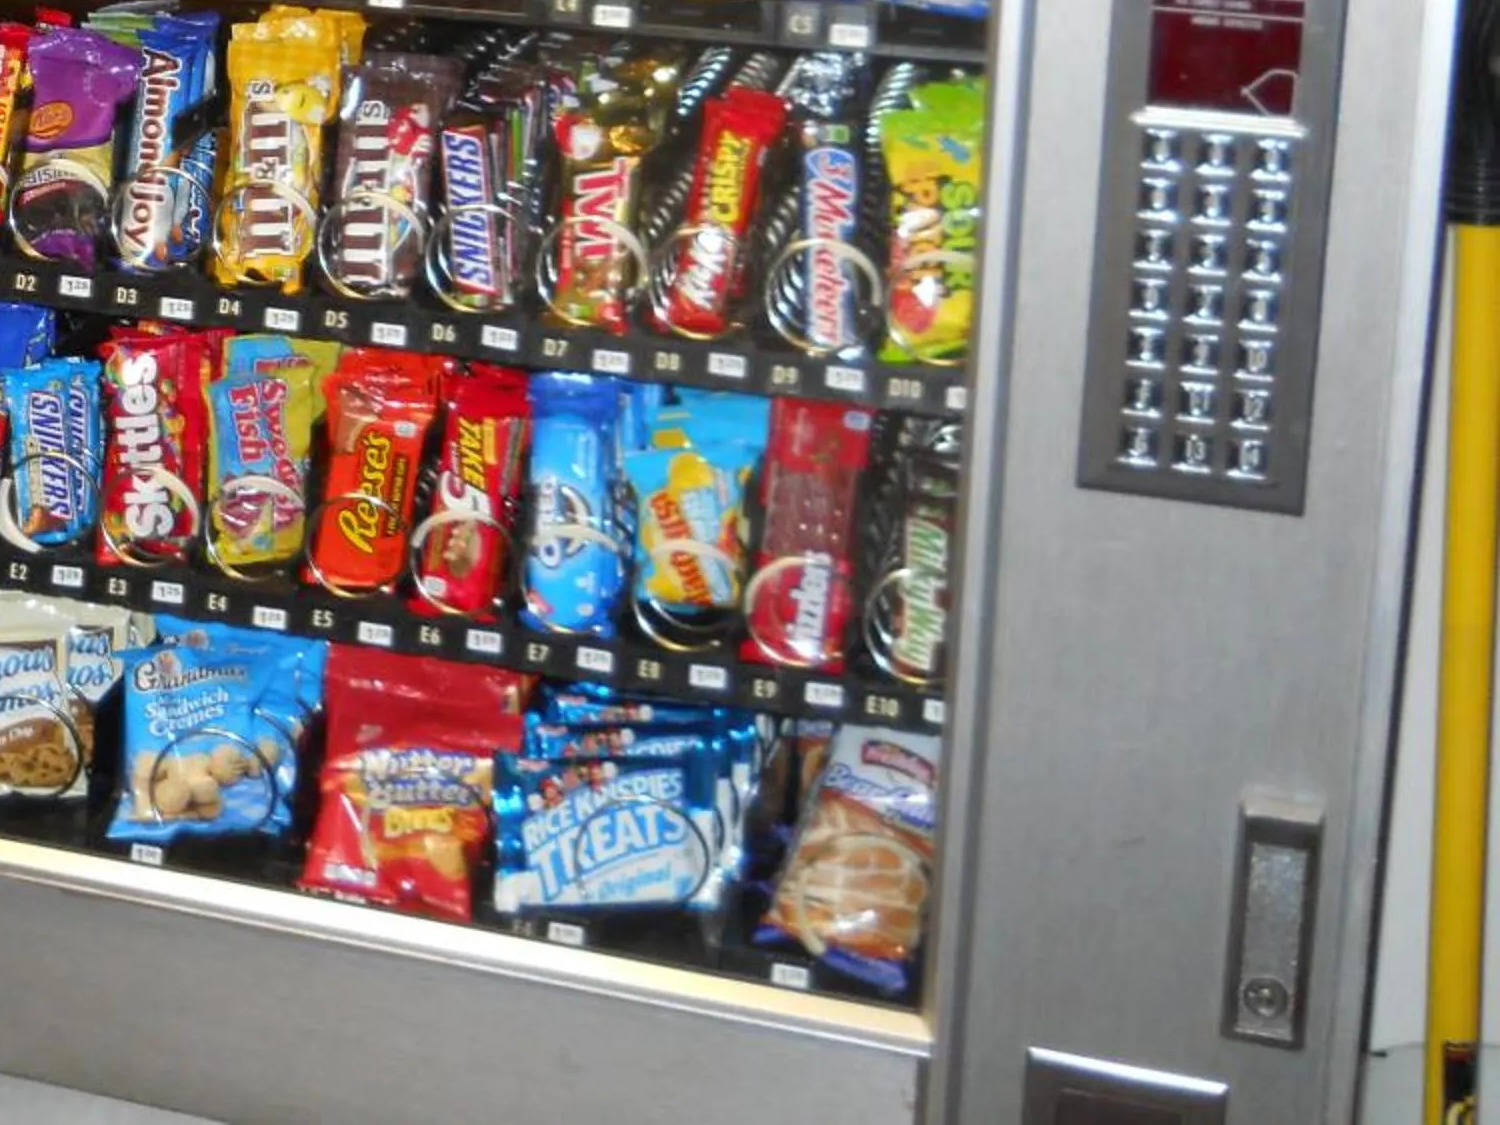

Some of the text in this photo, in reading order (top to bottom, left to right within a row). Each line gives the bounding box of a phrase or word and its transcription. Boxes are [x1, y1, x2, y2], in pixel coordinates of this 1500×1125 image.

[123, 183, 165, 248] Joy
[15, 273, 37, 292] D2
[116, 286, 137, 305] D3
[219, 298, 241, 316] D4
[325, 310, 349, 329] D5
[432, 323, 456, 342] D6
[543, 337, 568, 357] D7
[228, 382, 270, 465] Fish
[457, 416, 487, 491] TAKE
[9, 562, 28, 581] E2
[108, 577, 128, 596] E3
[207, 592, 228, 612] E4
[312, 608, 333, 628] E5
[420, 626, 441, 645] E6
[527, 642, 549, 662] E7
[754, 678, 778, 699] E9
[865, 694, 900, 717] E10
[522, 800, 575, 851] RICE
[529, 803, 688, 903] TREATS
